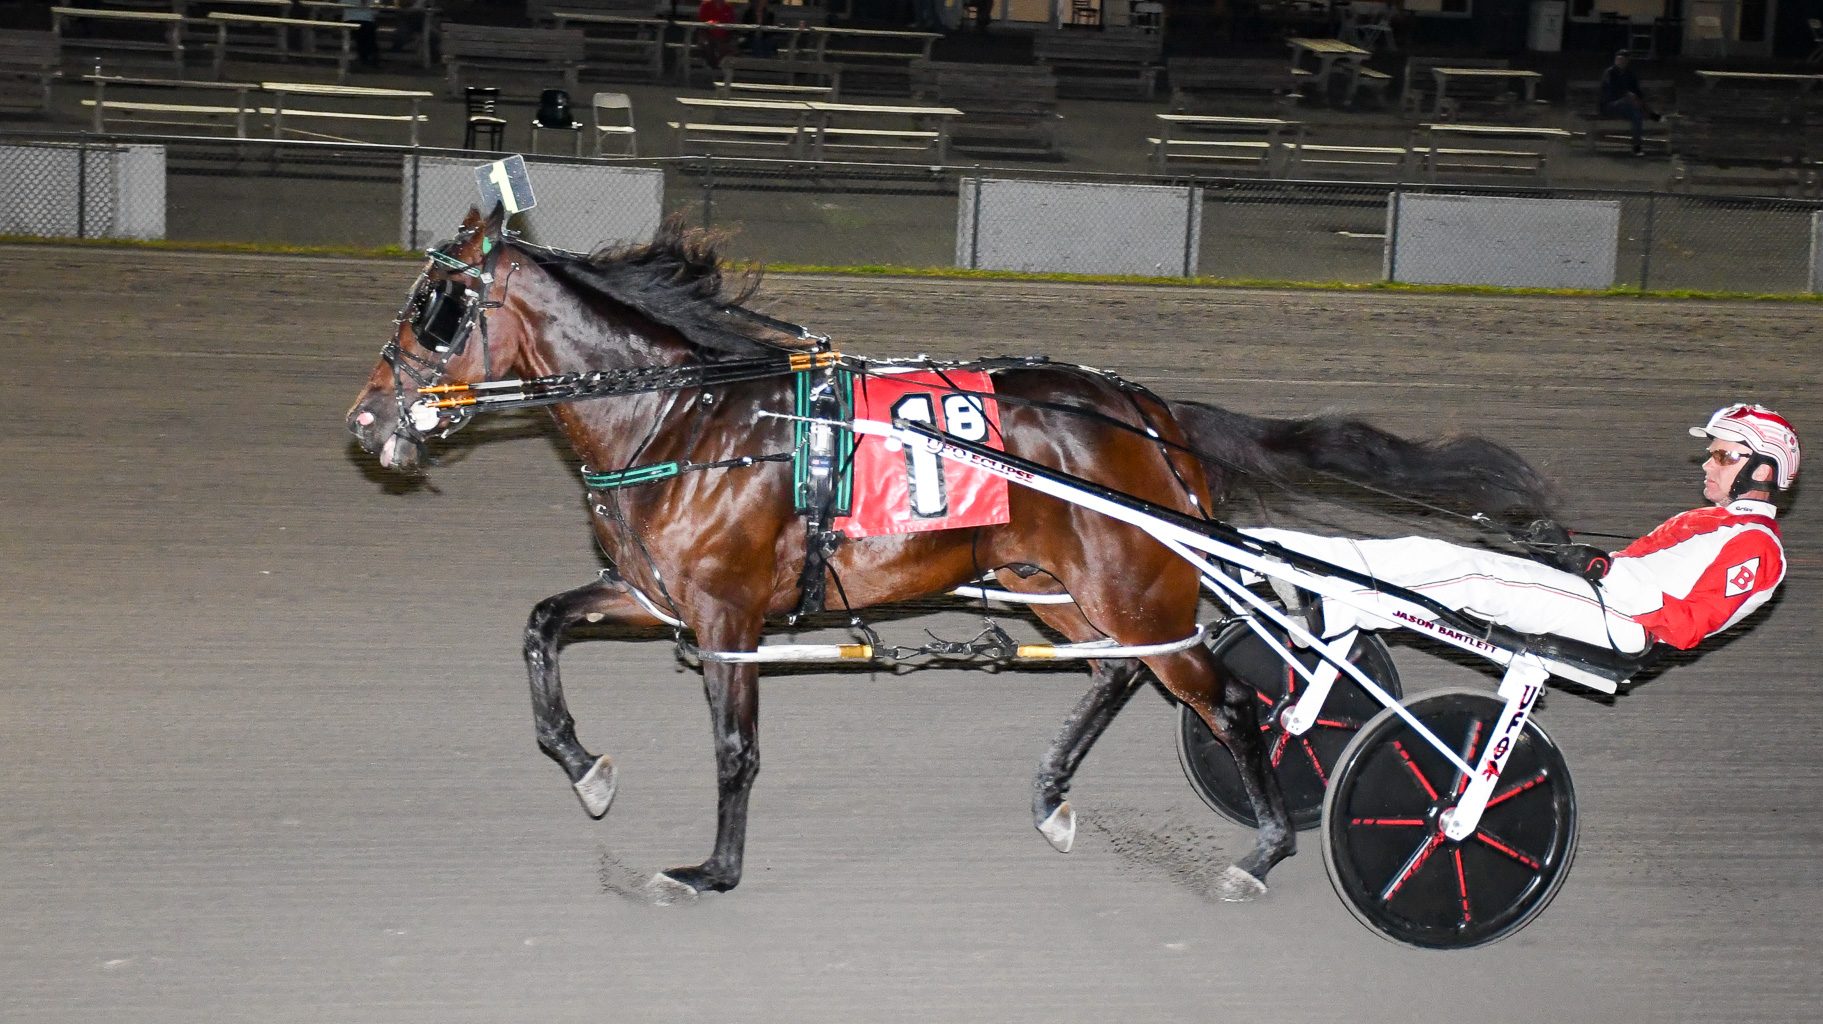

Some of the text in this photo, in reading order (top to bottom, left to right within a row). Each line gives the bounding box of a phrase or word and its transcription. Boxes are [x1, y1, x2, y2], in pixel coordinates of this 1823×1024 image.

[488, 161, 519, 213] 1
[942, 392, 988, 444] 8
[890, 392, 948, 518] 1
[971, 454, 1035, 483] ECLIPSE
[1730, 566, 1755, 591] B
[1392, 610, 1498, 654] JASON BARTLETT
[1492, 685, 1538, 760] UFO
